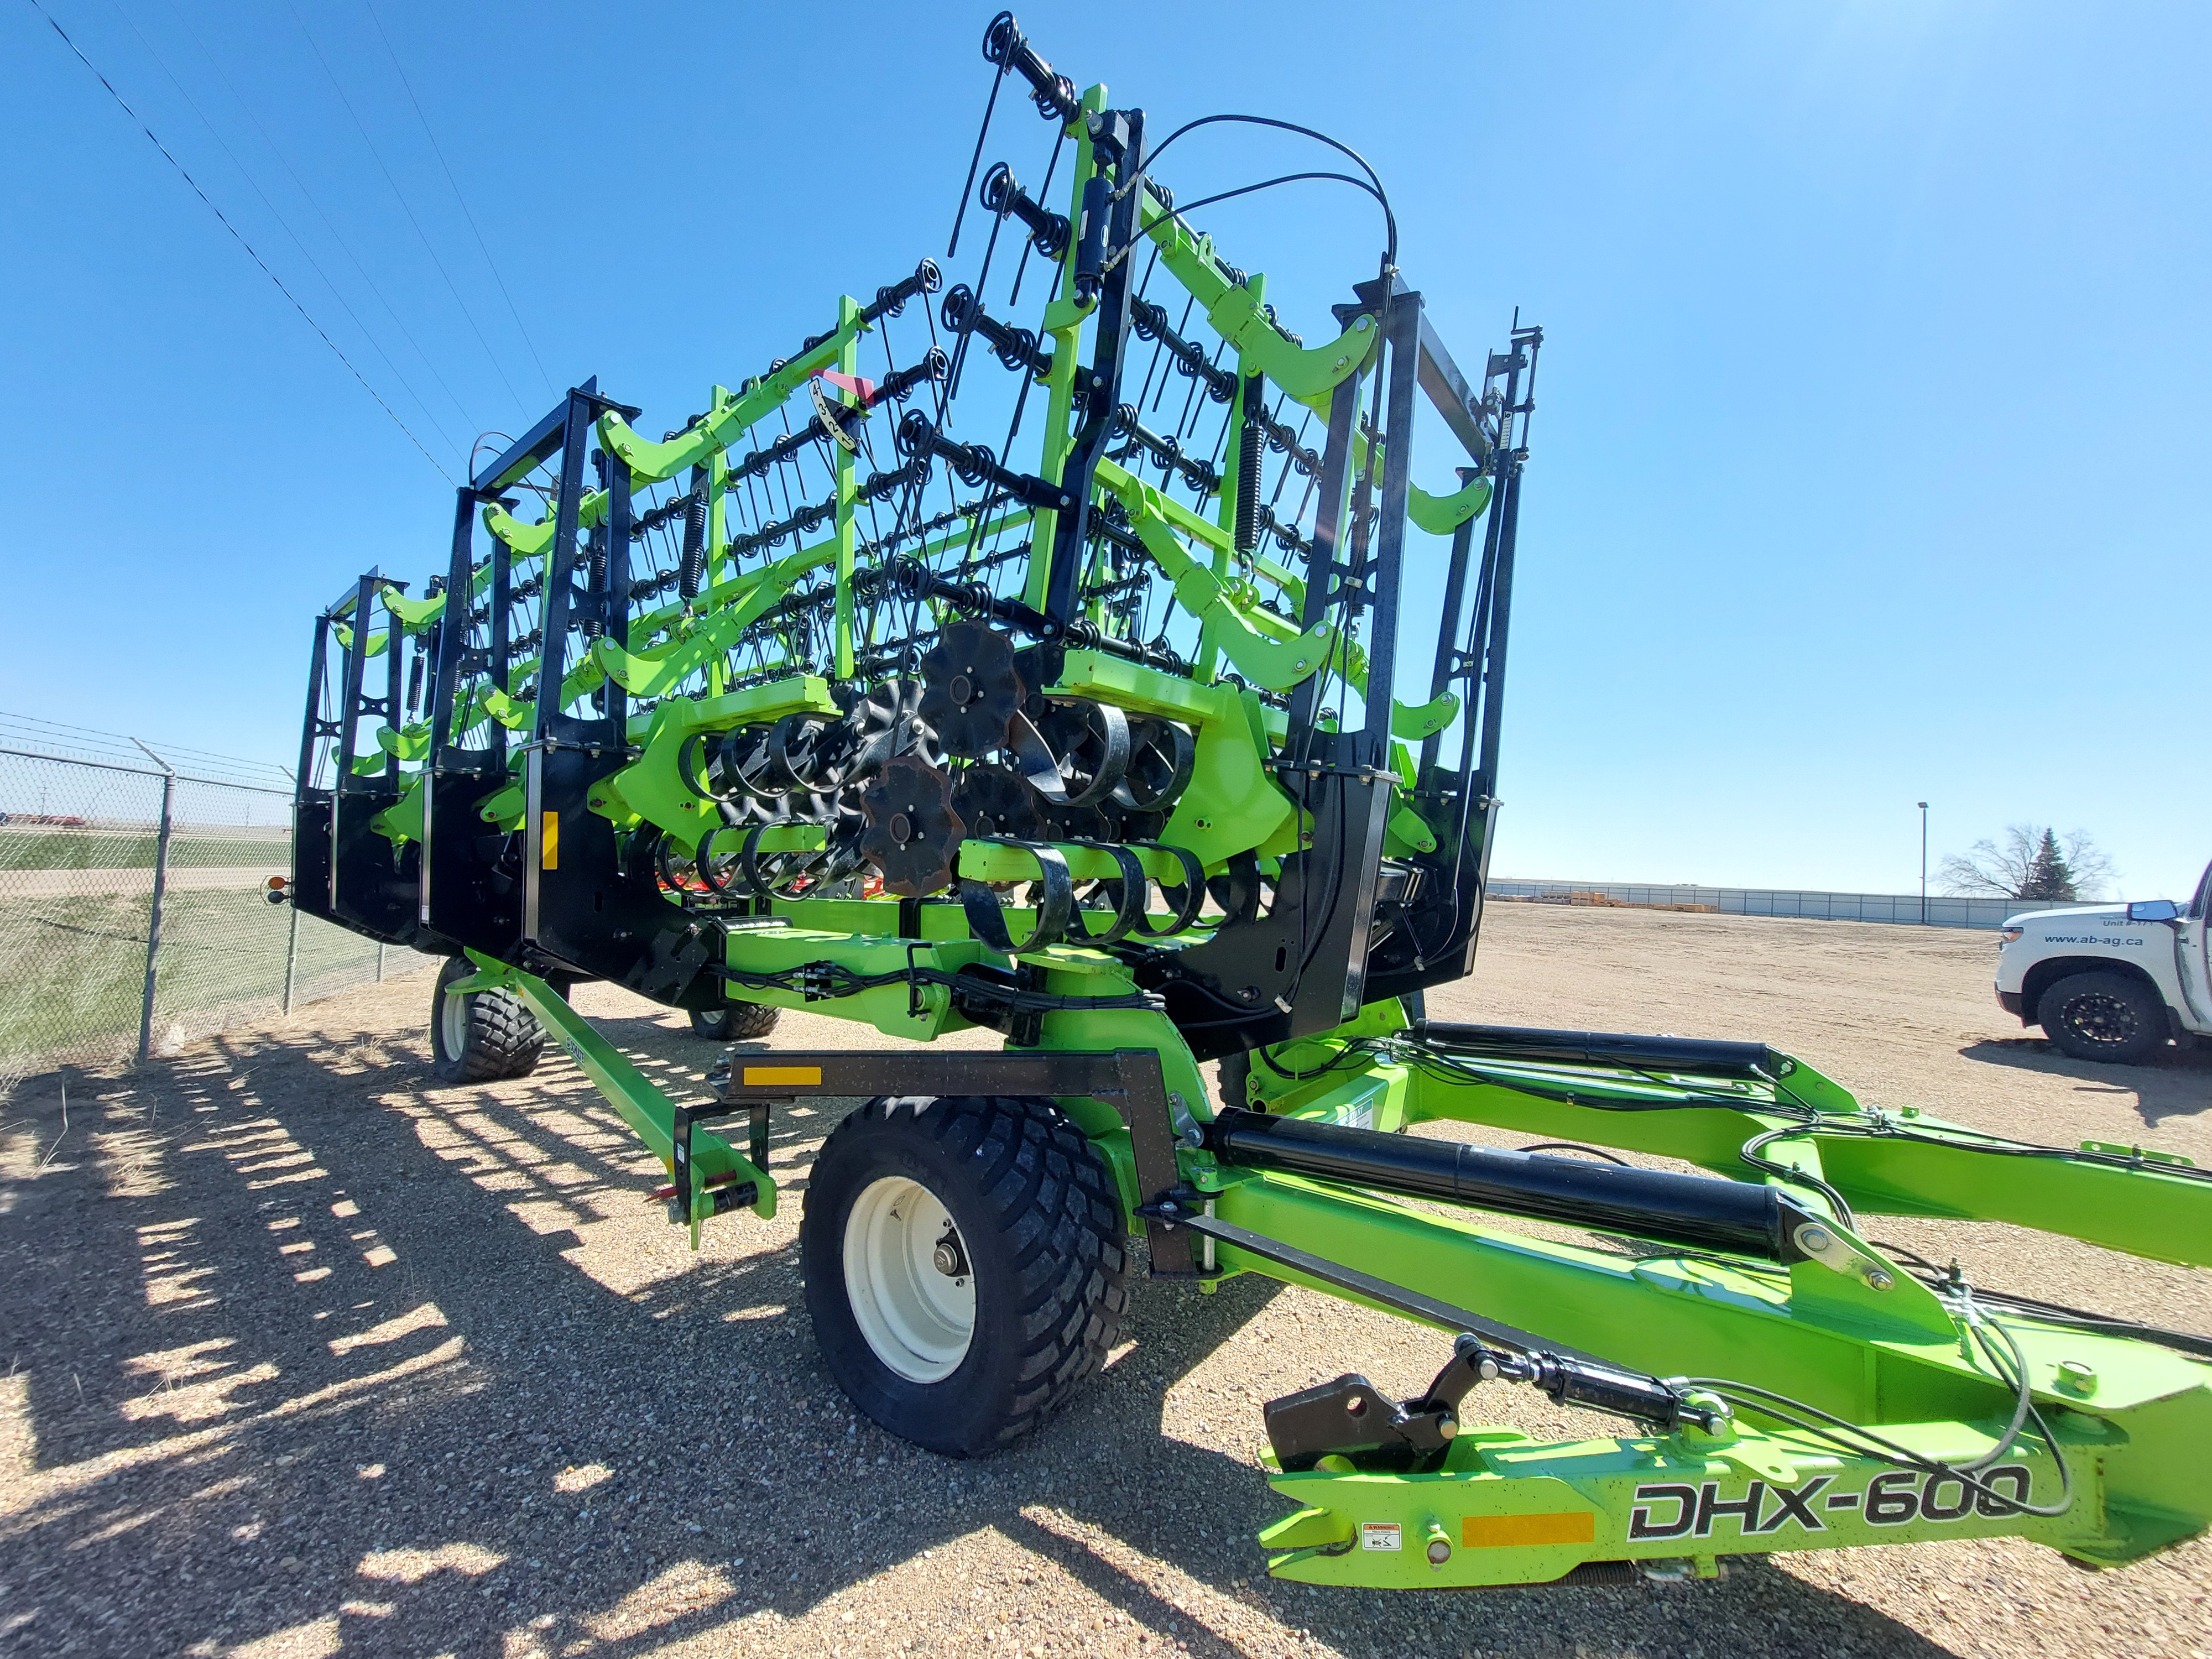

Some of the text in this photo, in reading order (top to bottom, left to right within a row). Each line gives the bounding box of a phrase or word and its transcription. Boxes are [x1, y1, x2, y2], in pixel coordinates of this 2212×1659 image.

[813, 384, 818, 397] 4
[818, 403, 827, 415] 3
[828, 421, 838, 433] 2
[842, 436, 851, 446] 1
[2044, 935, 2143, 947] www.ab-ag.ca
[1626, 1464, 2032, 1543] DHX-600
